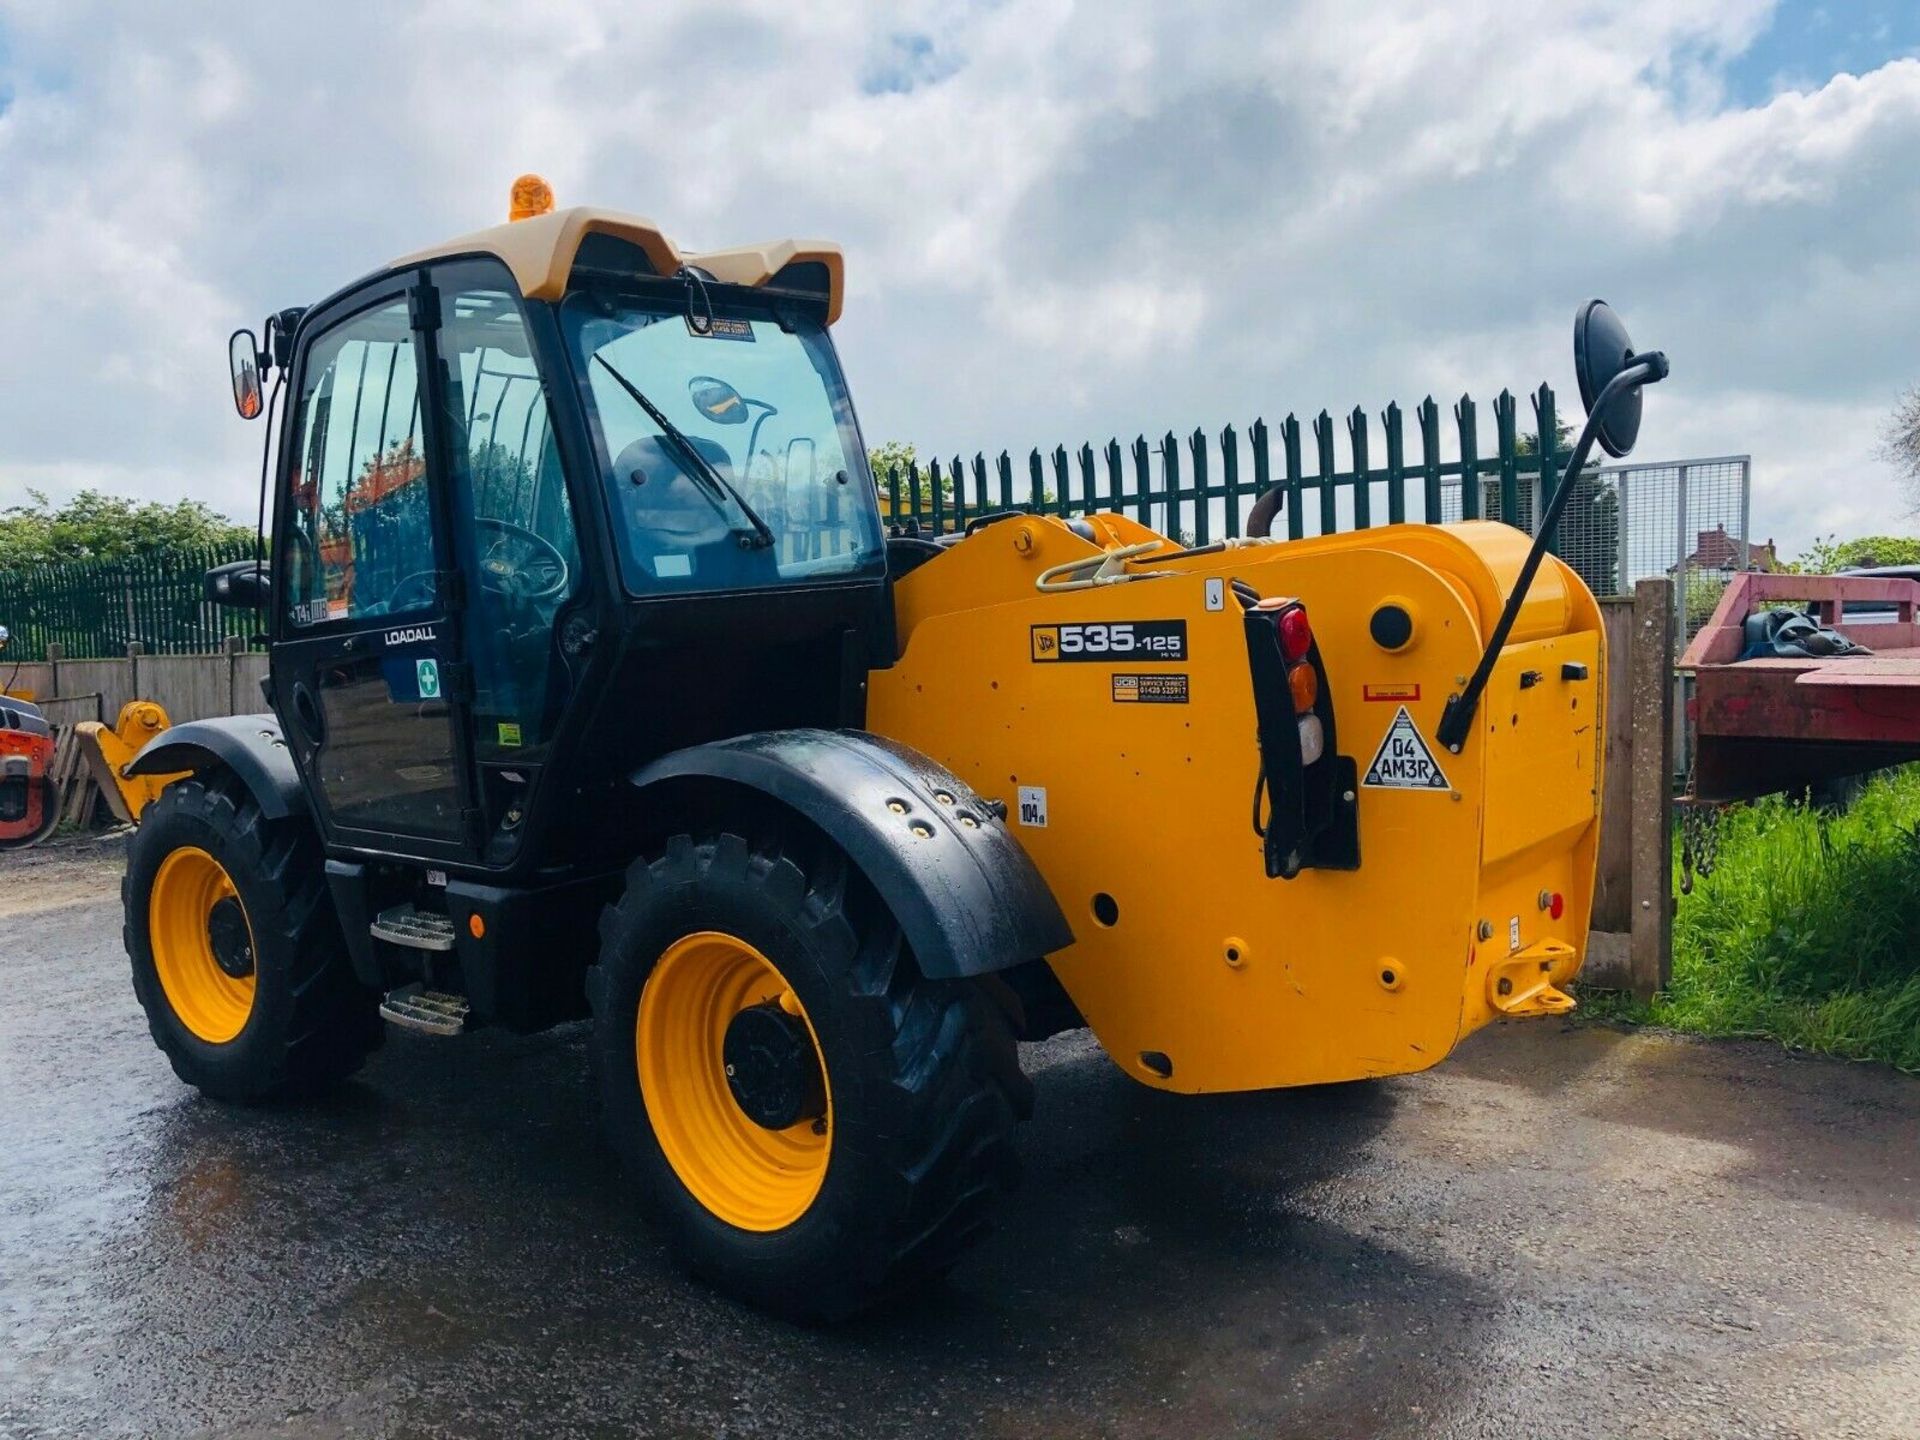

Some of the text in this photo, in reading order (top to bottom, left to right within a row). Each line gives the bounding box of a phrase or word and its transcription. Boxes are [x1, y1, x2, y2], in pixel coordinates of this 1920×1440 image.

[384, 626, 437, 646] LOADALL
[1114, 677, 1137, 687] JCB
[1381, 759, 1430, 780] AM3R
[1022, 803, 1038, 823] 104
